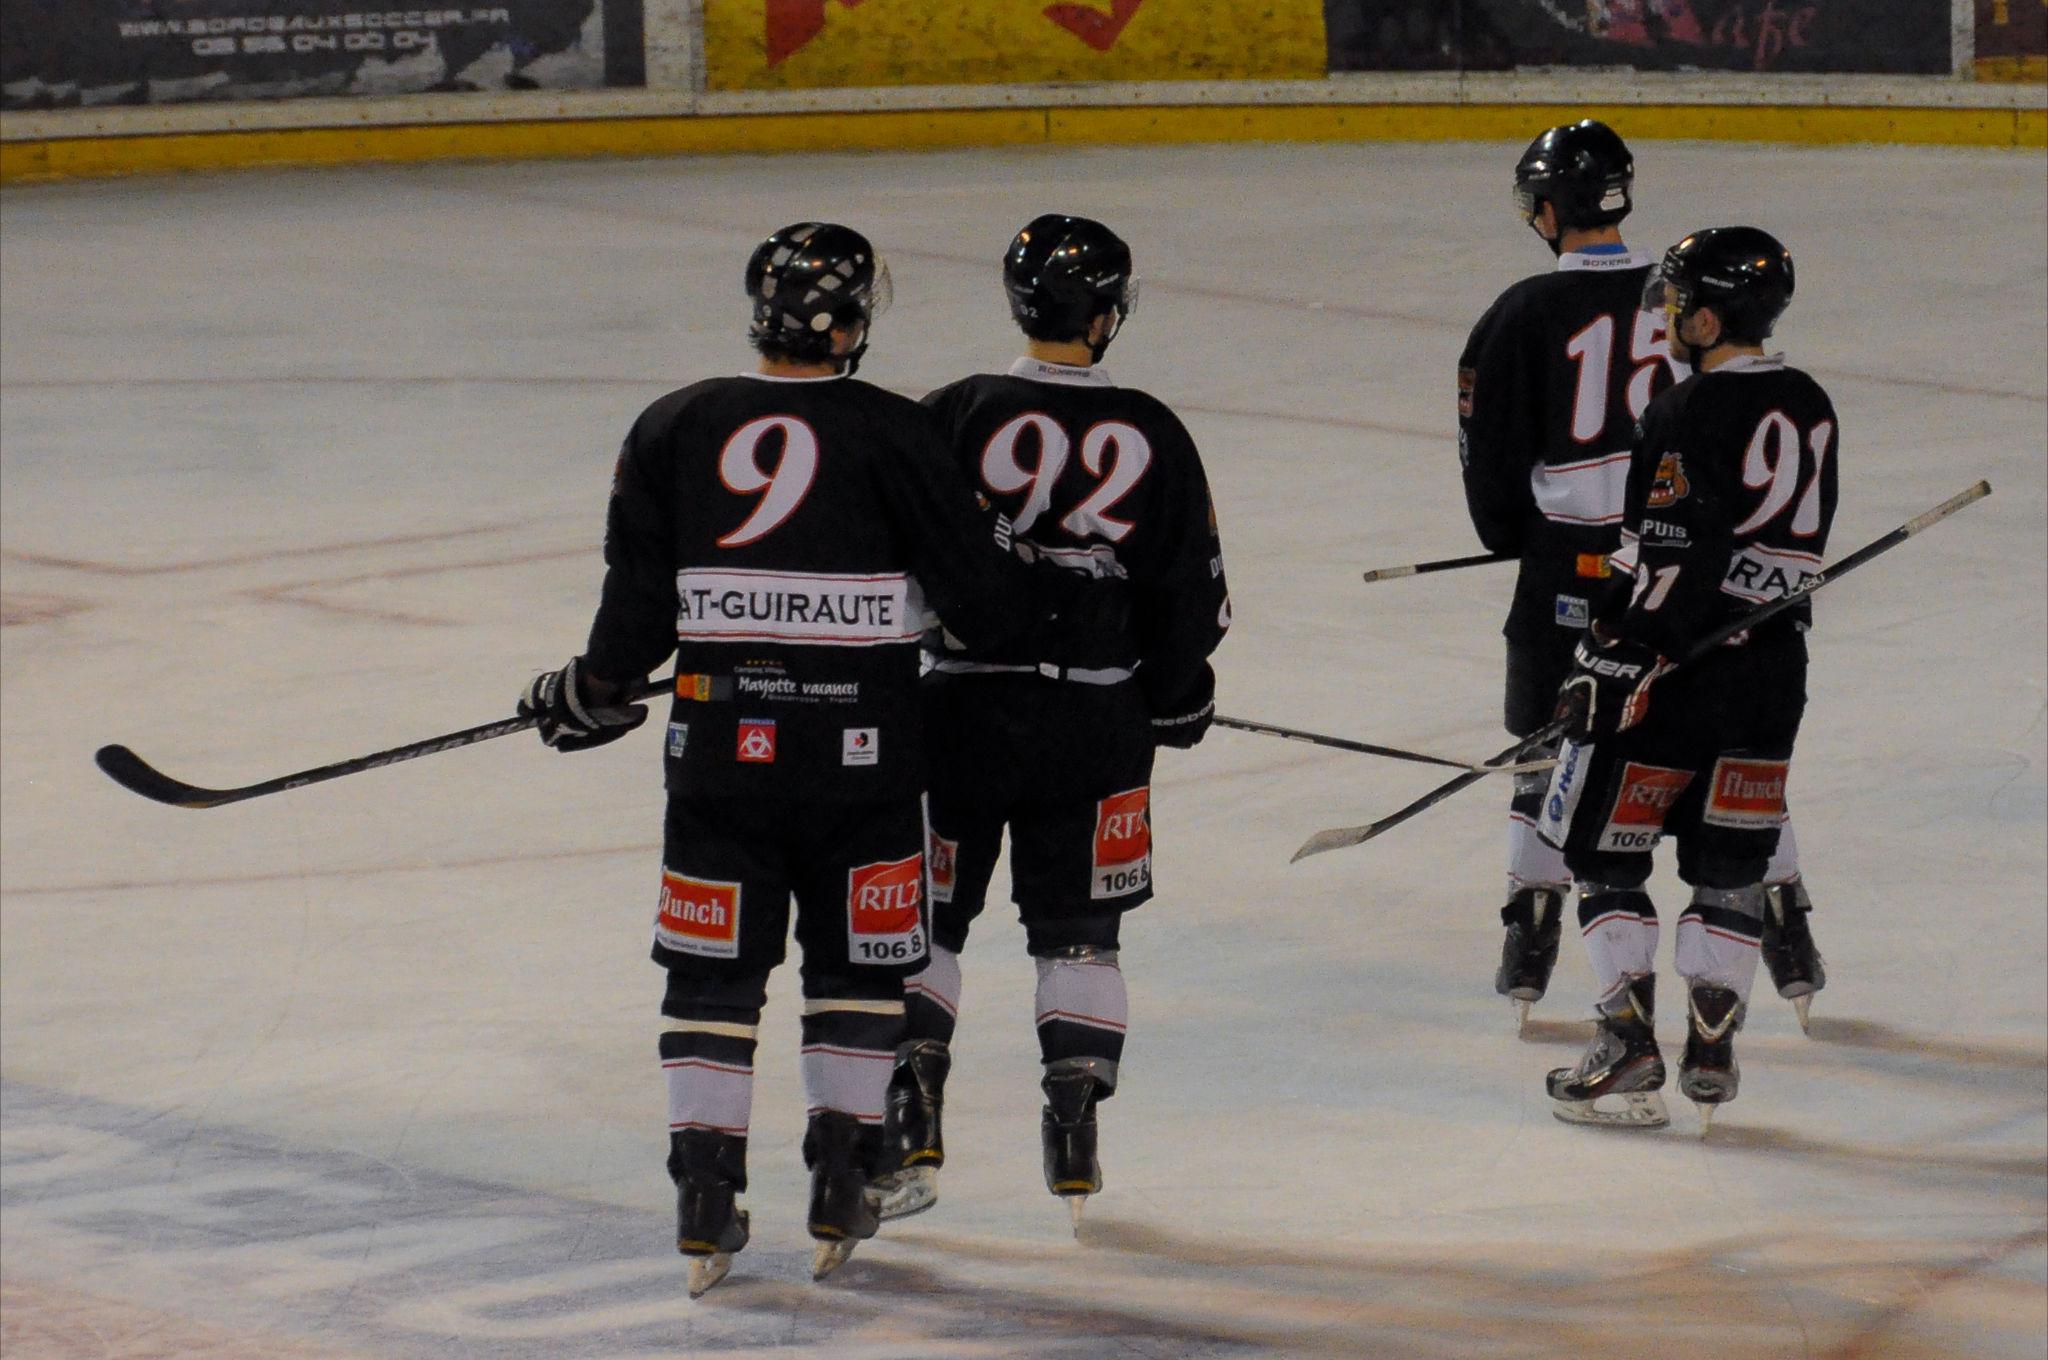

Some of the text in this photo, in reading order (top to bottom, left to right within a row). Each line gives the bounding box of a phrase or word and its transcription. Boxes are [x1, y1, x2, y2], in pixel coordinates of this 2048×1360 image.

[716, 413, 820, 548] 9
[980, 410, 1152, 547] 92
[1733, 409, 1832, 537] 91
[738, 676, 860, 700] Mayotte vacances
